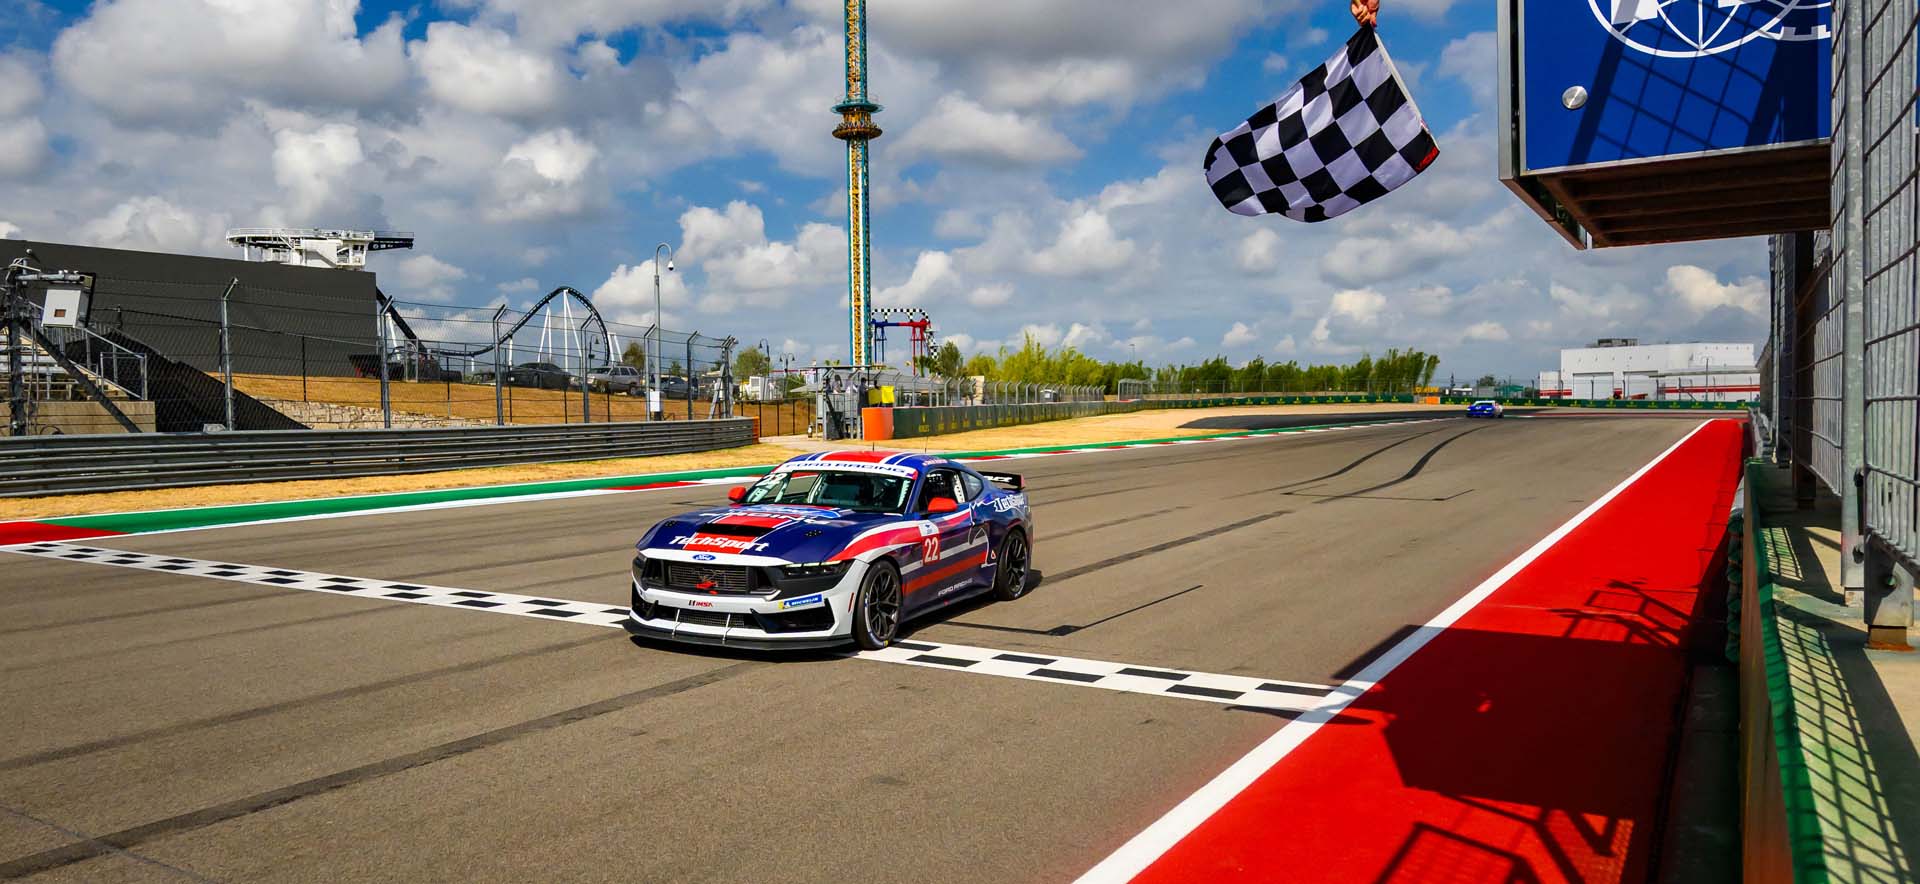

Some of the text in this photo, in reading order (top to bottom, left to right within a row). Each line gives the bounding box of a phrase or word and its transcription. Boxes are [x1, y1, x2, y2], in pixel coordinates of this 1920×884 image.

[834, 462, 908, 474] RACING
[668, 535, 770, 552] TechSport
[924, 536, 939, 563] 22
[937, 577, 973, 597] FORD RACING
